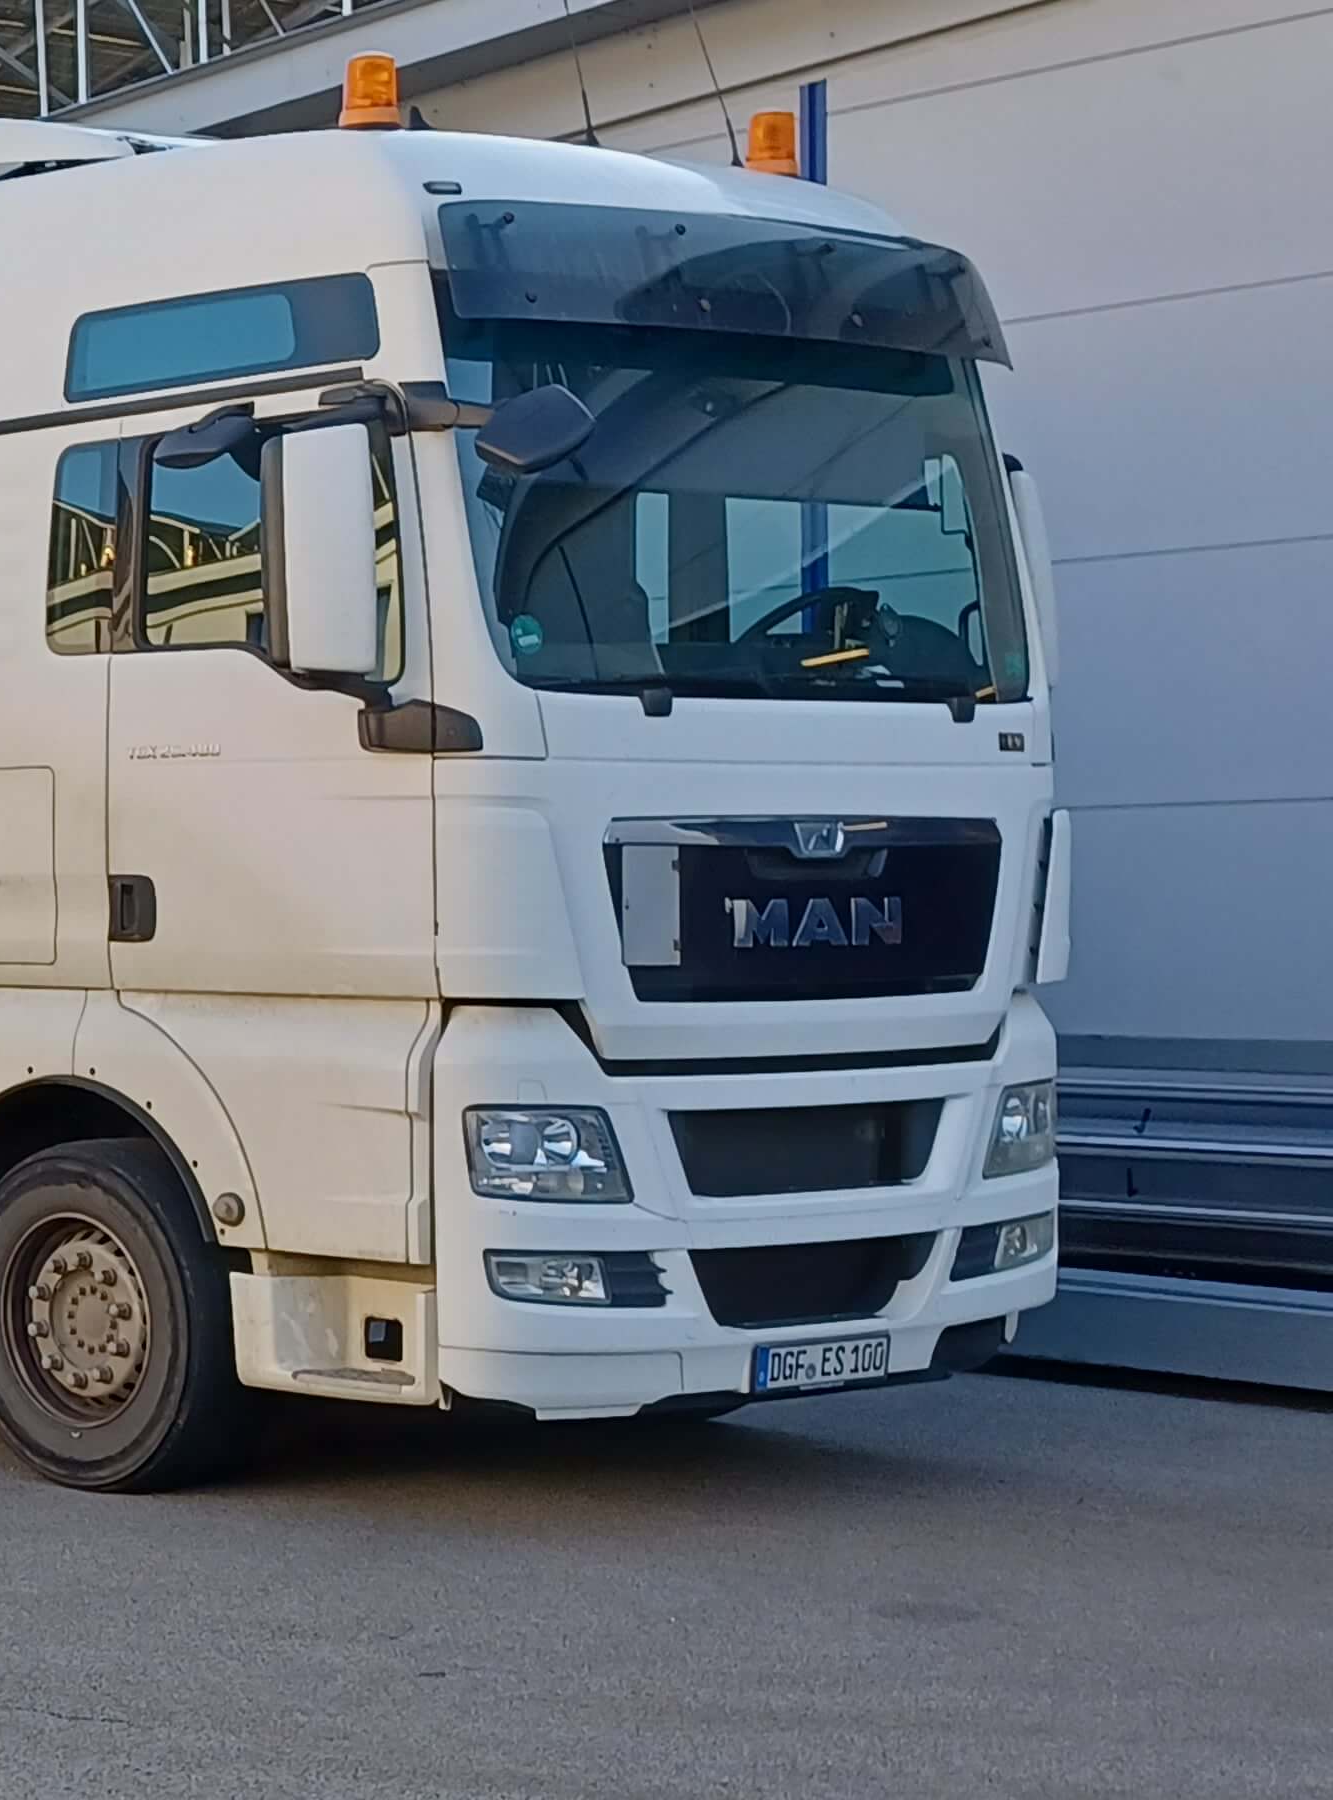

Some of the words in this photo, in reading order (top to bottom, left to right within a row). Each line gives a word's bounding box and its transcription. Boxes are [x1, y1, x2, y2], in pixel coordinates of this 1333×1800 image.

[725, 896, 903, 948] MAN
[769, 1350, 808, 1382] DGF
[821, 1345, 846, 1377] ES
[849, 1341, 884, 1374] 100
